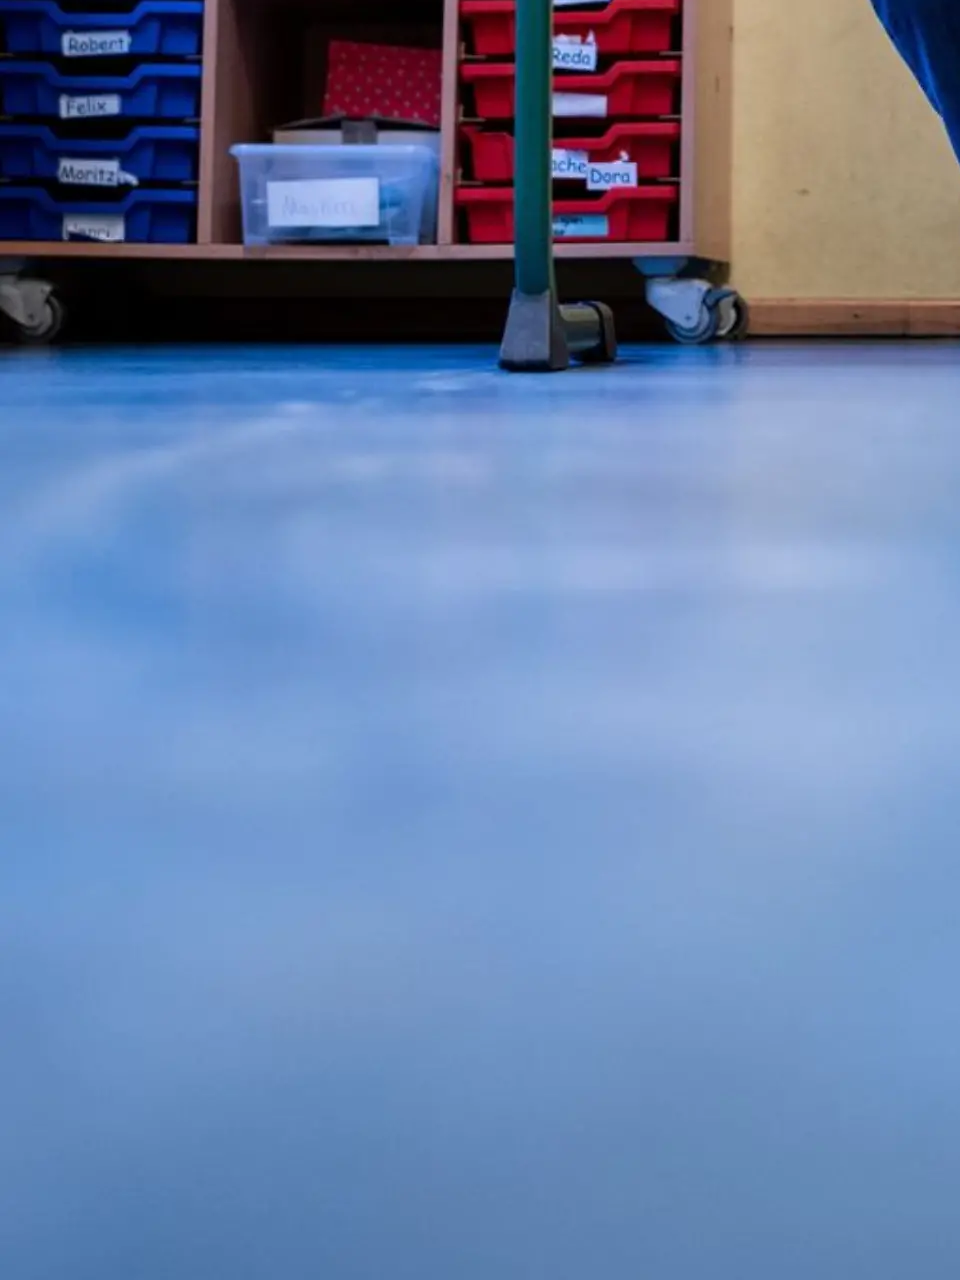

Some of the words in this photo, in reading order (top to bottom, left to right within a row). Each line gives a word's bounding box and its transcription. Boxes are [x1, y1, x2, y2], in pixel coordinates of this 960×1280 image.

[67, 35, 126, 53] Robert
[66, 98, 107, 116] Felix
[60, 163, 118, 182] Moritz
[590, 167, 630, 185] Dora
